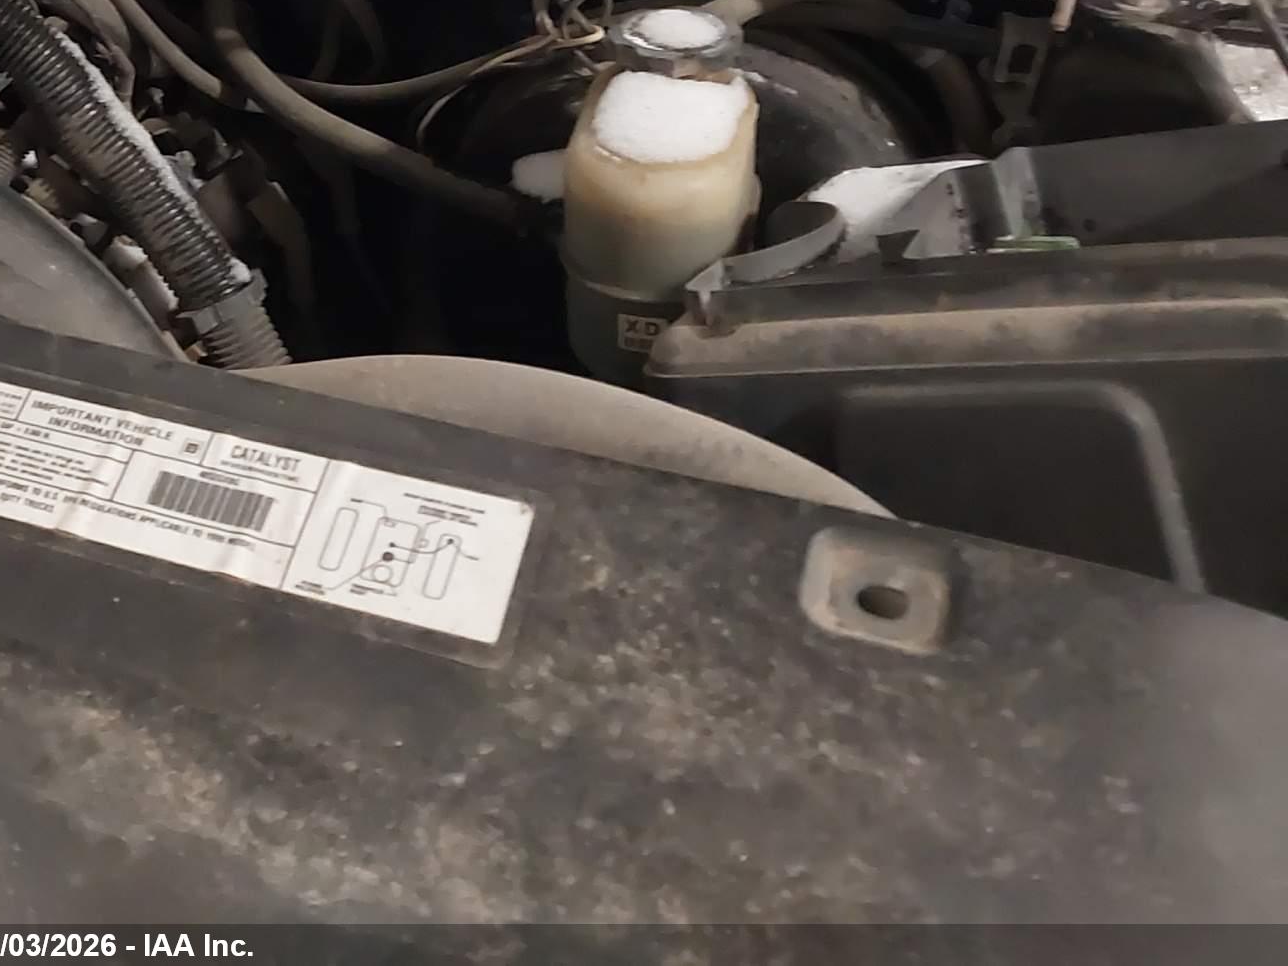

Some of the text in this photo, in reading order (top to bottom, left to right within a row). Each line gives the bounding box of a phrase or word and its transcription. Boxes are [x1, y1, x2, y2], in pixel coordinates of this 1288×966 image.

[32, 400, 112, 425] IMPORTANT
[116, 418, 174, 441] VEHICLE
[48, 417, 145, 447] INFORMATION
[231, 445, 302, 472] CATALYST
